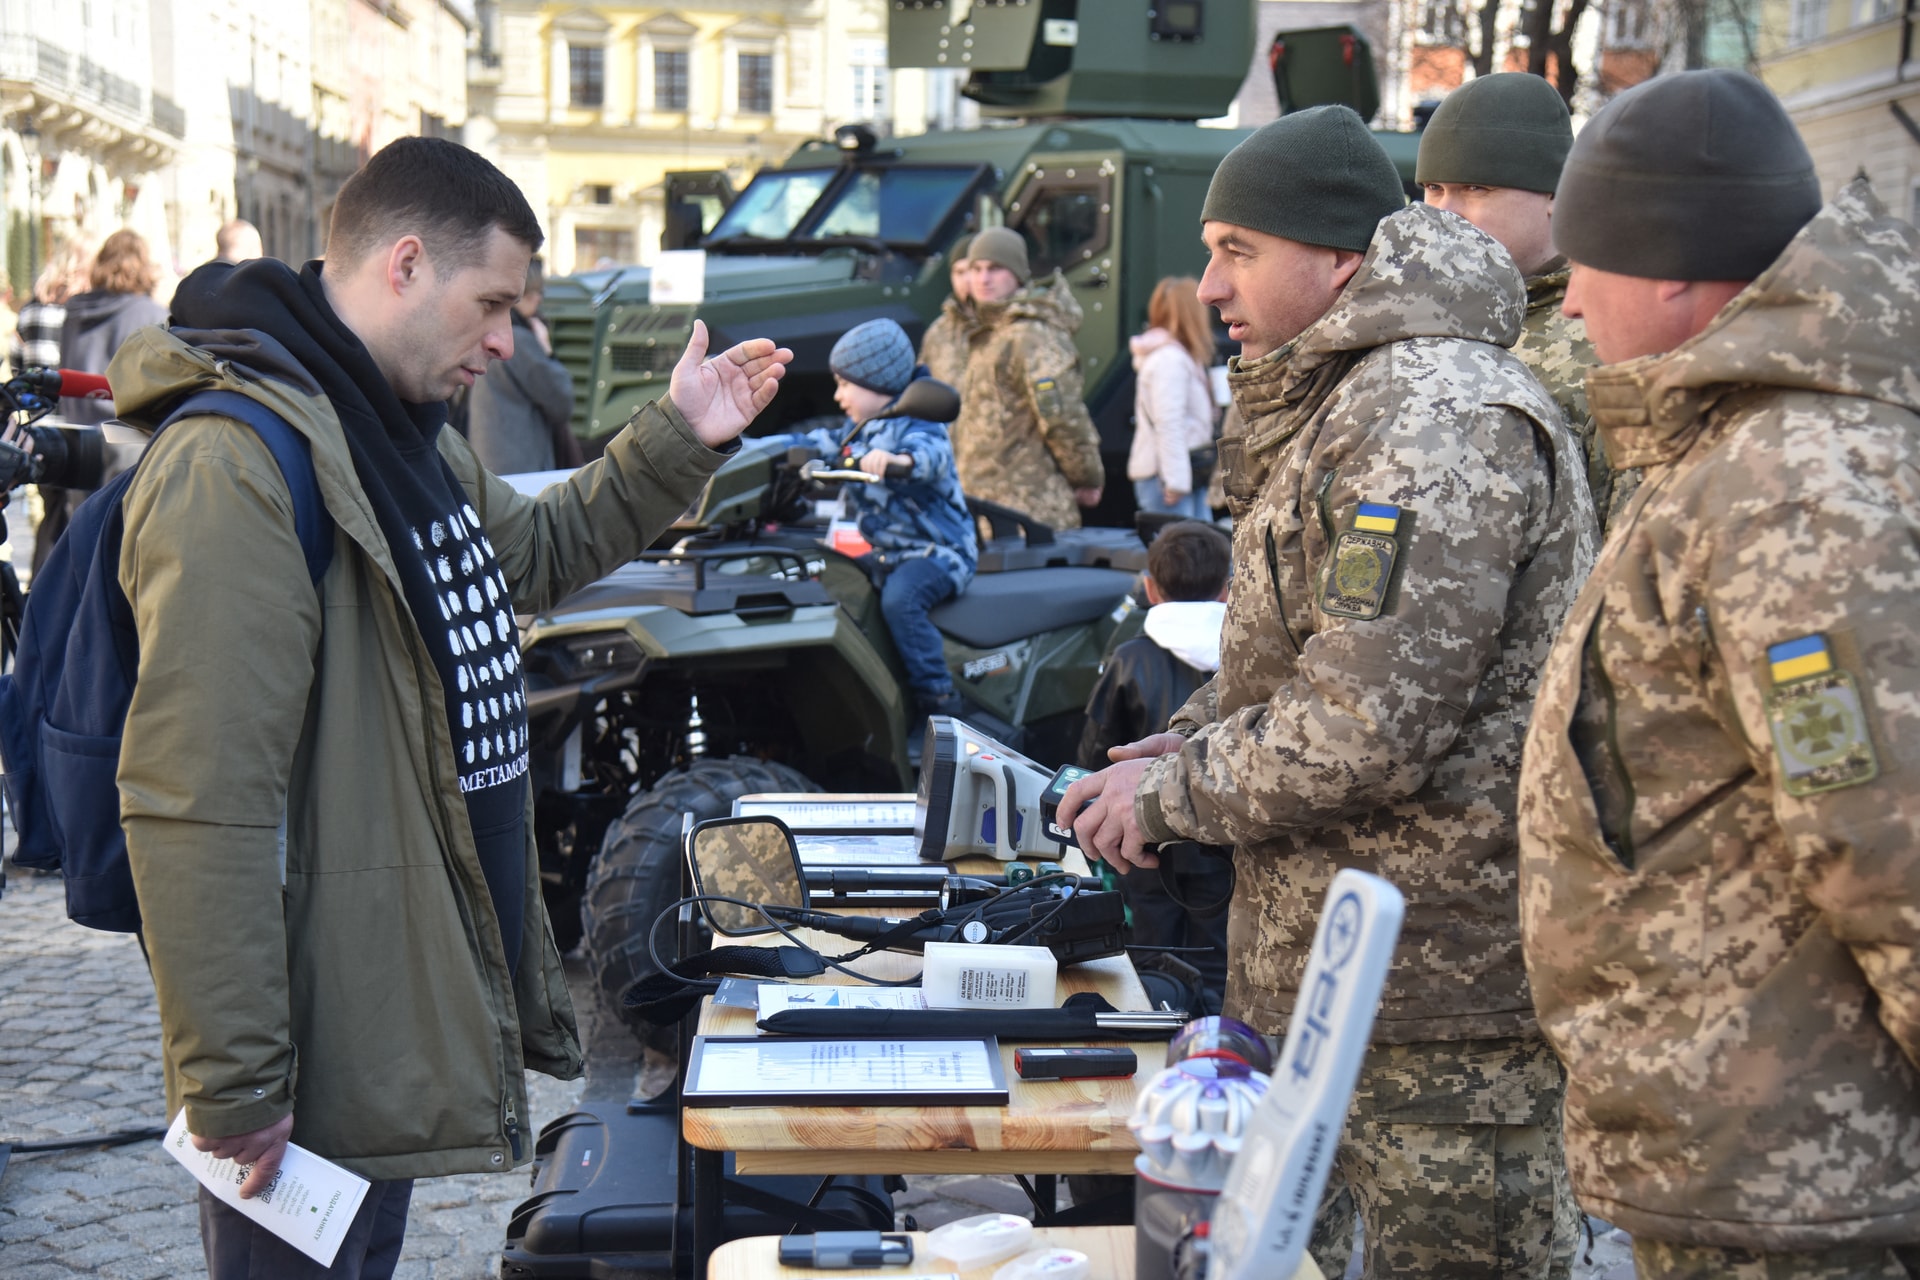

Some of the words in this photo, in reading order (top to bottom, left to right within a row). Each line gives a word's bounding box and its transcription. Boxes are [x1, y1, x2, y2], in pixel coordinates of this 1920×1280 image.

[1346, 535, 1387, 550] ДЕРЖАВНА
[459, 750, 529, 793] METAMOR
[324, 1190, 341, 1217] ПОДАТИ
[314, 1217, 328, 1240] АНКЕТУ
